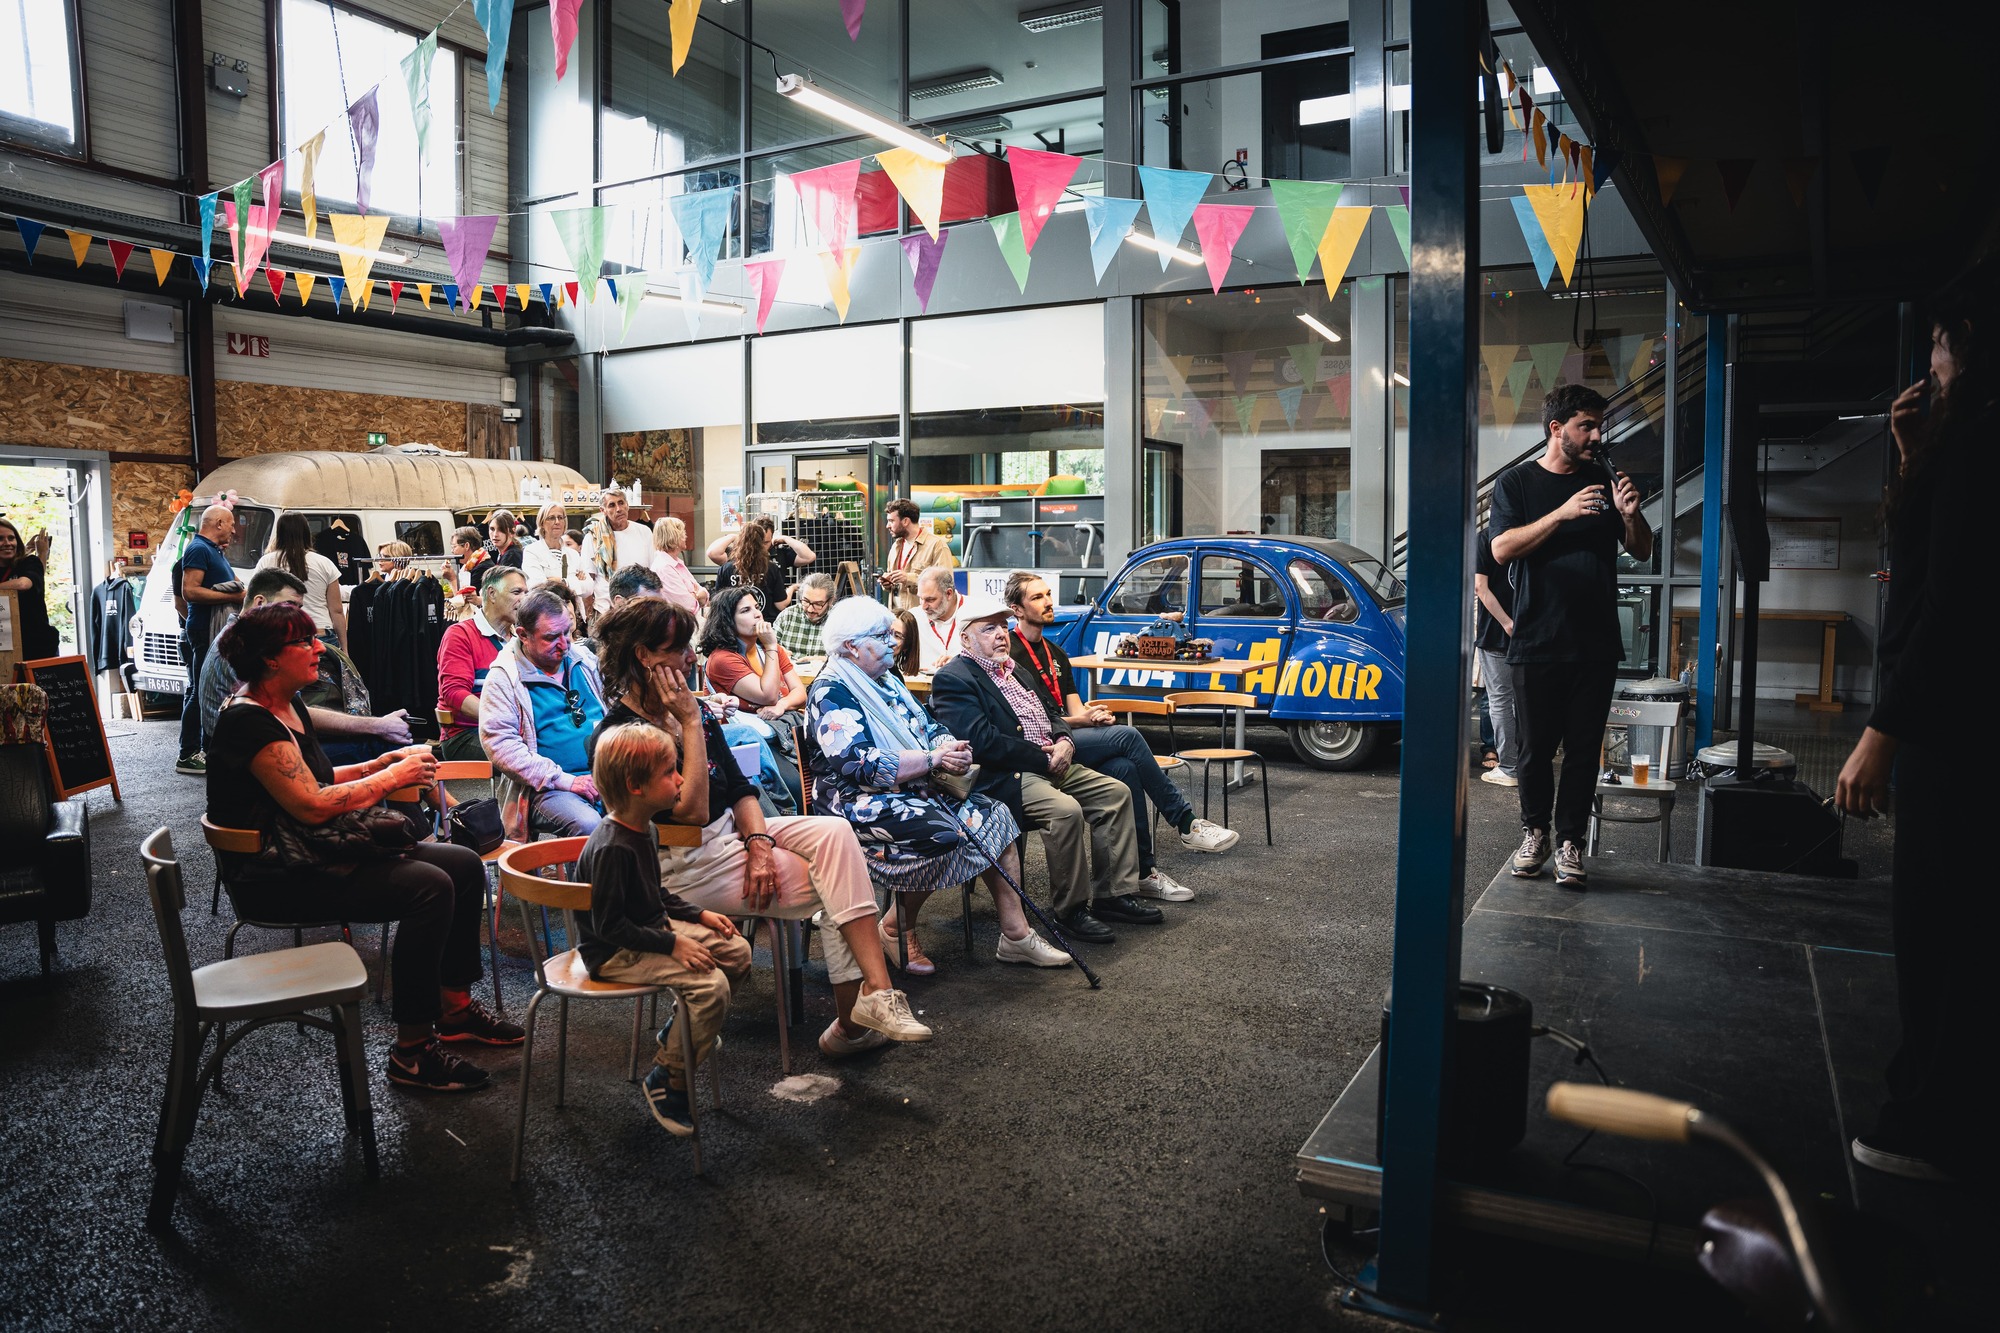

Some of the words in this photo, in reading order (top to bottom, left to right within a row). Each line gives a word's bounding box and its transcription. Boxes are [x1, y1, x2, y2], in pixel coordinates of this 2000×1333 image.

[985, 579, 1008, 596] KID
[148, 678, 157, 690] FA
[156, 679, 170, 691] 643
[170, 680, 181, 692] VG
